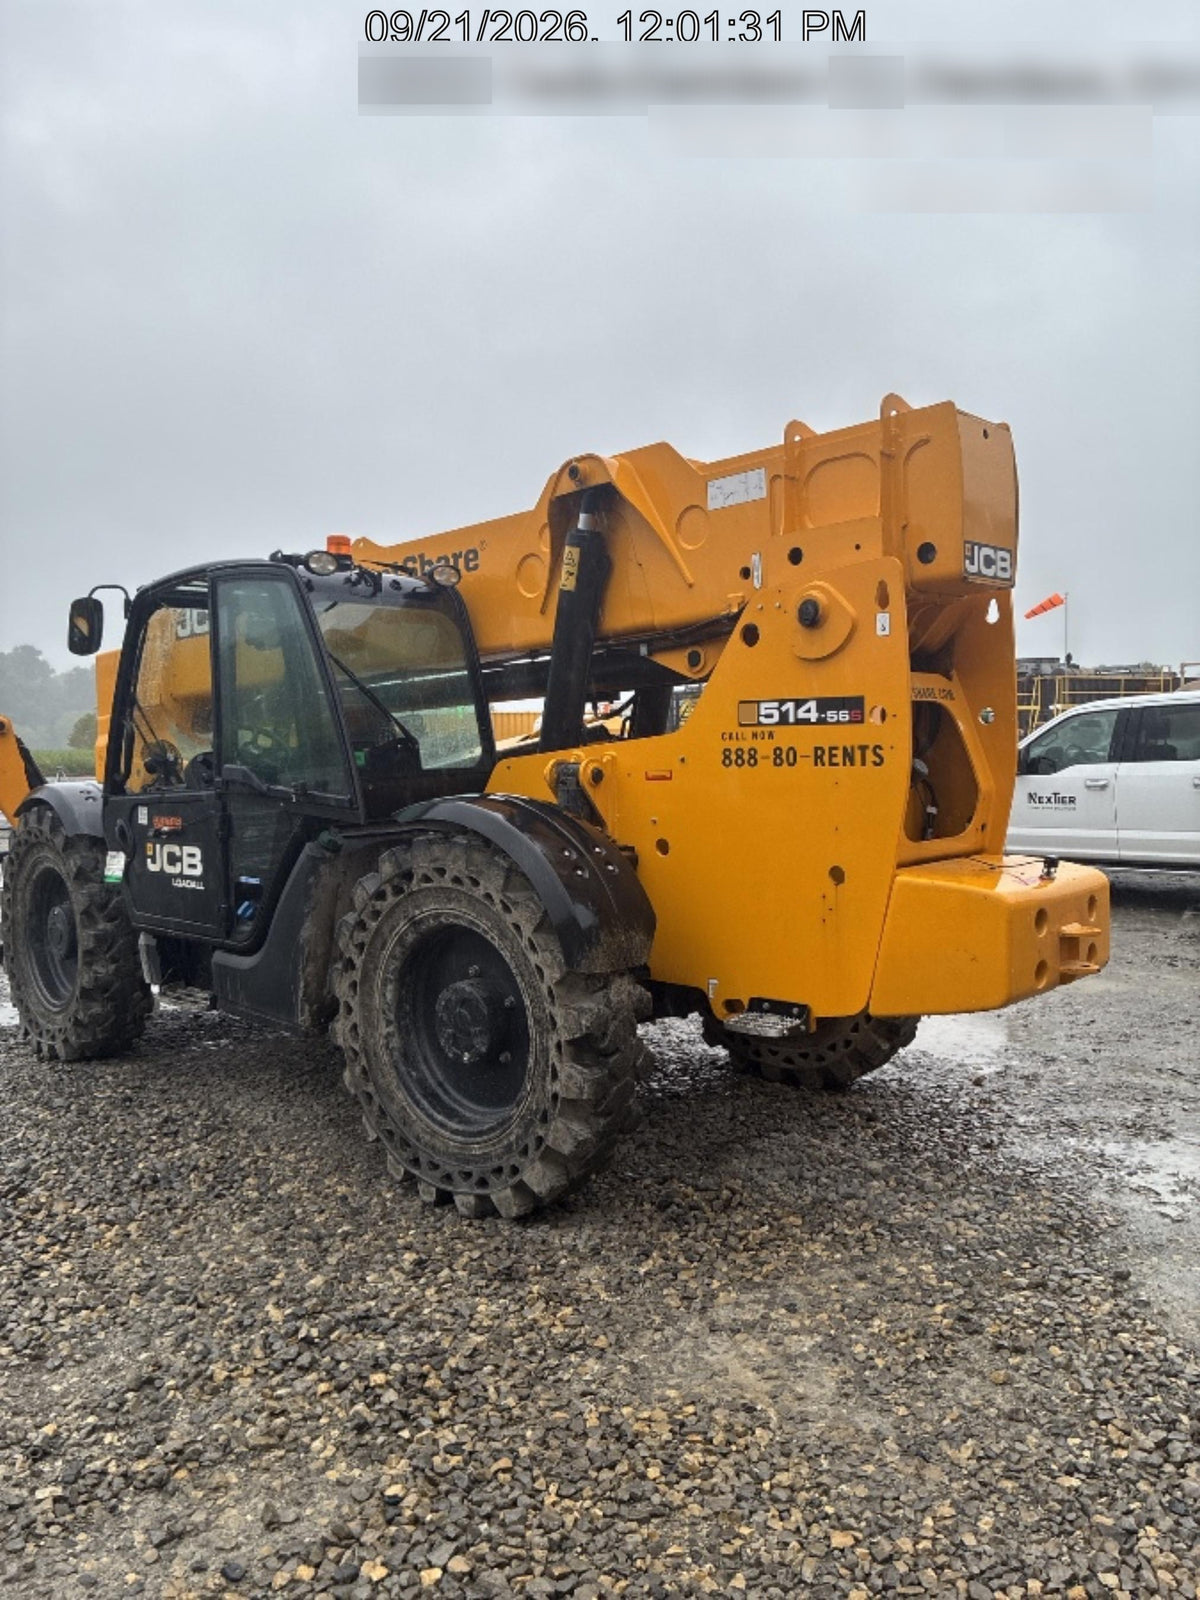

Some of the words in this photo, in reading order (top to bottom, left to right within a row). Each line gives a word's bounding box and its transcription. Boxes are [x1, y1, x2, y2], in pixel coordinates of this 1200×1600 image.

[965, 544, 1011, 579] JCB
[177, 607, 209, 638] JC
[721, 731, 747, 742] CALL
[751, 730, 775, 741] NOW
[721, 745, 884, 768] 888-80-RENTS
[146, 843, 203, 876] JCB
